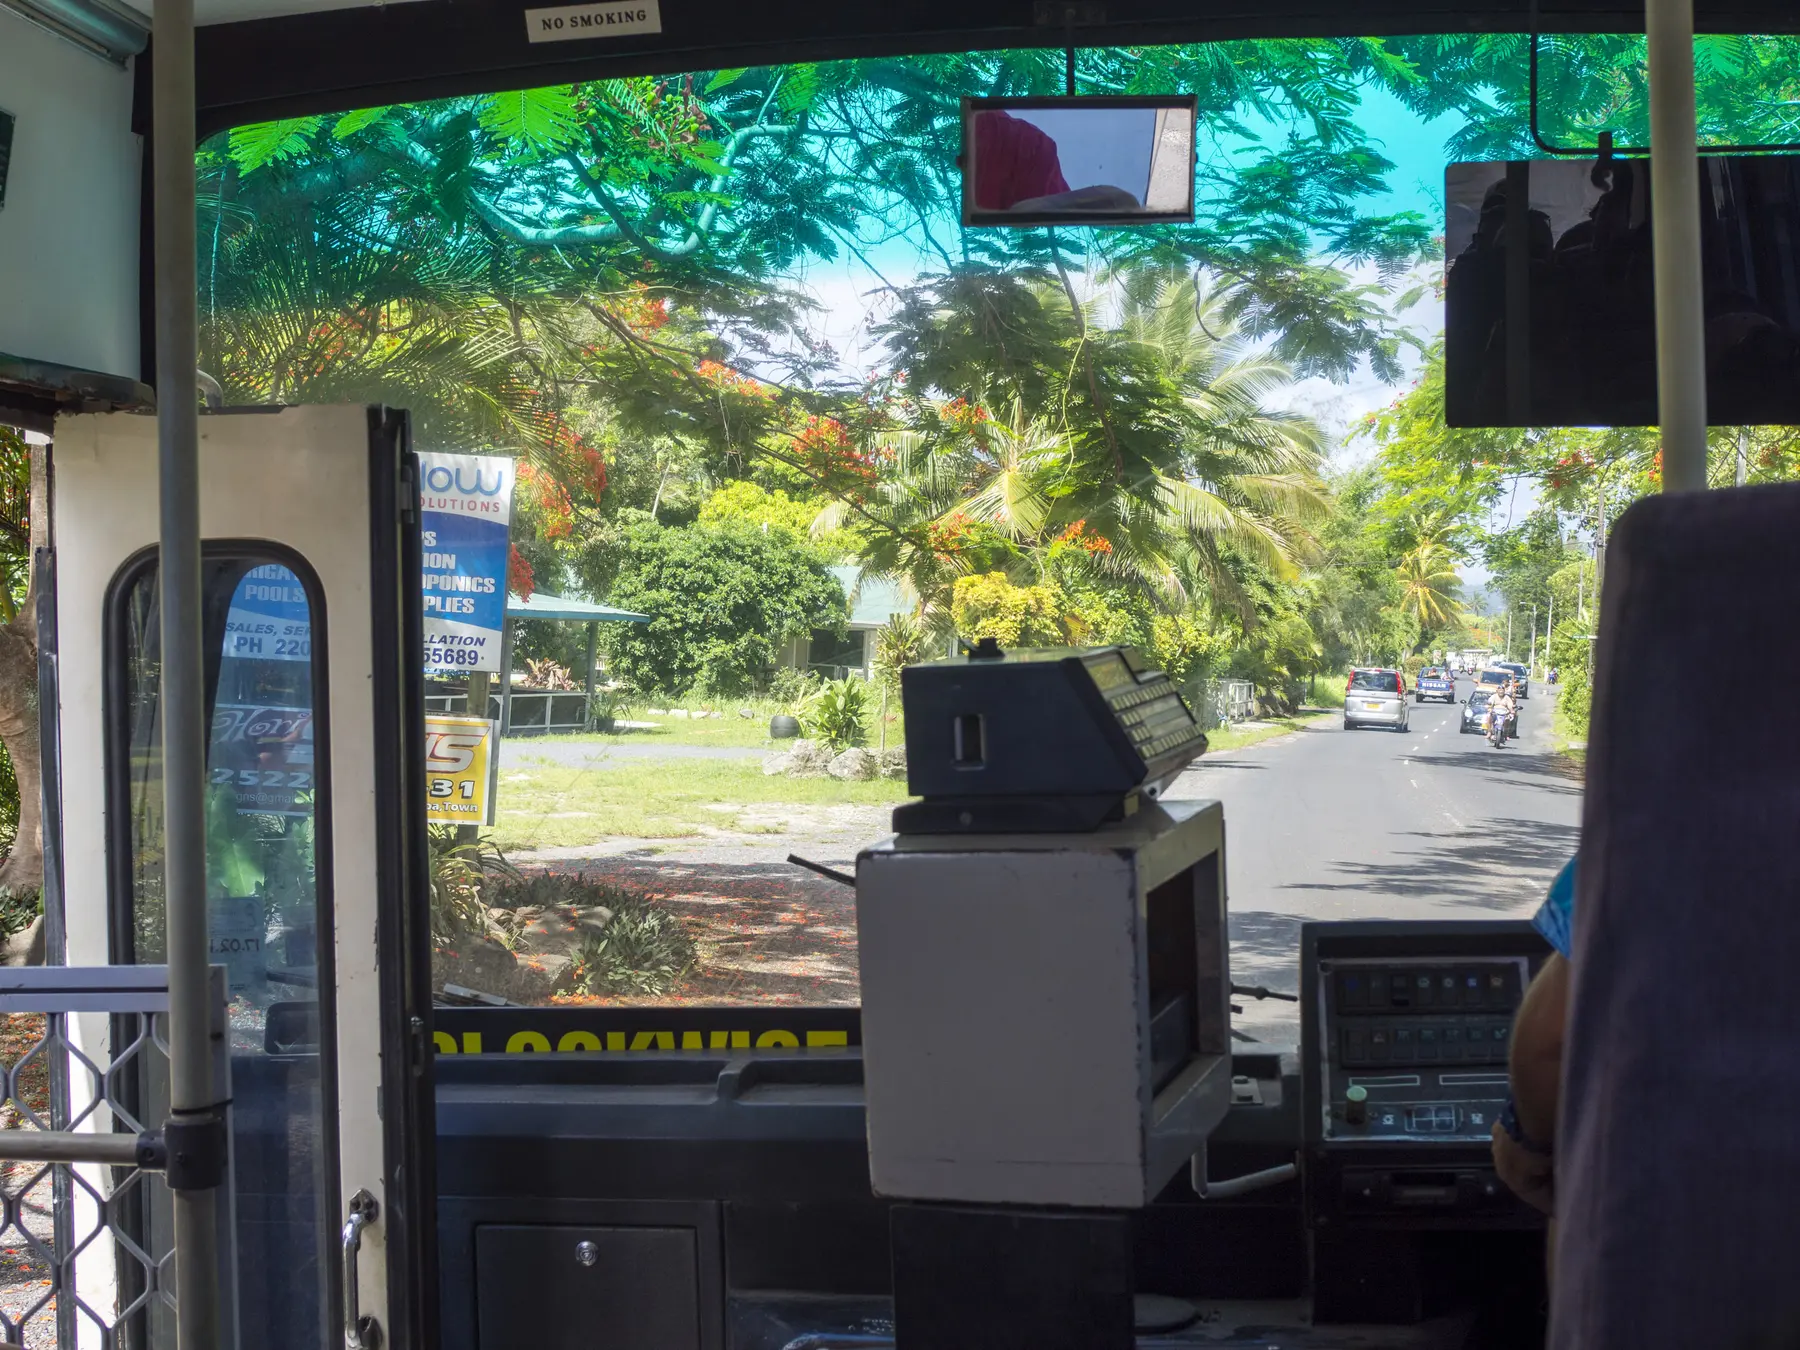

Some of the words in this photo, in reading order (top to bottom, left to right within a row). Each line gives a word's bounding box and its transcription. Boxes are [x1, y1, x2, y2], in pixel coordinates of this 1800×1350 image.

[541, 17, 564, 31] NO
[570, 9, 647, 28] SMOKING
[422, 531, 437, 547] S
[422, 552, 456, 570] ION
[245, 584, 305, 603] POOLS
[423, 595, 475, 614] PLIES
[236, 636, 263, 654] PH
[423, 634, 486, 647] LATION
[426, 778, 475, 799] 31
